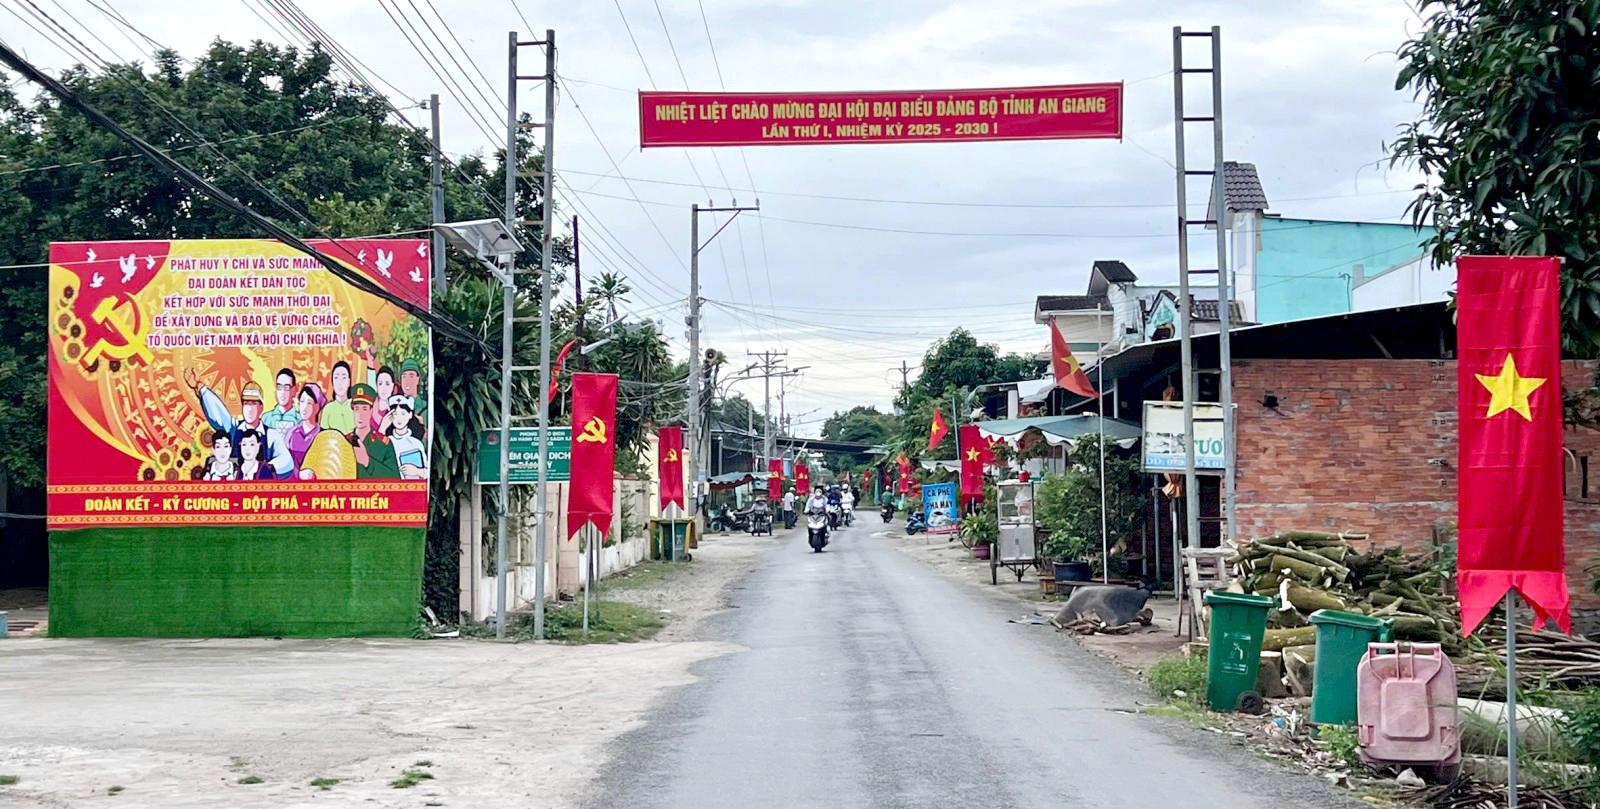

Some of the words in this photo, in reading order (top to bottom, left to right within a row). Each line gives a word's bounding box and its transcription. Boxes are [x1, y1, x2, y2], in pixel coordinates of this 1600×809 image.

[656, 101, 696, 123] NHIỆT
[700, 101, 727, 123] LIỆT
[732, 100, 768, 120] CHÀO
[773, 100, 814, 119] MỪNG
[818, 102, 842, 121] ĐẠI
[846, 99, 869, 121] HỘI
[874, 102, 896, 120] ĐẠI
[901, 95, 932, 117] BIỂU
[937, 96, 975, 116] ĐẢNG
[980, 96, 998, 118] BỘ
[1002, 94, 1034, 115] TỈNH
[1038, 98, 1058, 114] AN
[1062, 97, 1106, 113] GIANG
[793, 123, 821, 137] THỨ
[824, 126, 832, 138] I,
[836, 123, 881, 138] NHIỆM
[908, 124, 941, 136] 2025
[955, 122, 988, 135] 2030
[993, 122, 998, 134] !
[200, 259, 219, 270] HUY
[253, 257, 265, 269] VÀ
[269, 256, 289, 269] SỨC
[188, 278, 205, 291] ĐẠI
[241, 275, 258, 288] KẾT
[164, 295, 182, 308] KẾT
[210, 295, 225, 307] VỚI
[229, 295, 249, 307] SỨC
[253, 297, 283, 309] MẠNH
[313, 296, 330, 309] ĐẠI
[226, 313, 238, 326] VÀ
[164, 331, 191, 346] QUỐC
[195, 333, 215, 348] VIỆT
[219, 335, 242, 346] NAM
[263, 332, 280, 346] HỘI
[85, 496, 122, 511] ĐOÀN
[126, 495, 150, 510] KẾT
[184, 497, 229, 510] CƯƠNG
[242, 495, 268, 512] ĐỘT
[271, 495, 299, 510] PHÁ
[311, 495, 346, 510] PHÁT
[350, 493, 388, 510] TRIỂN
